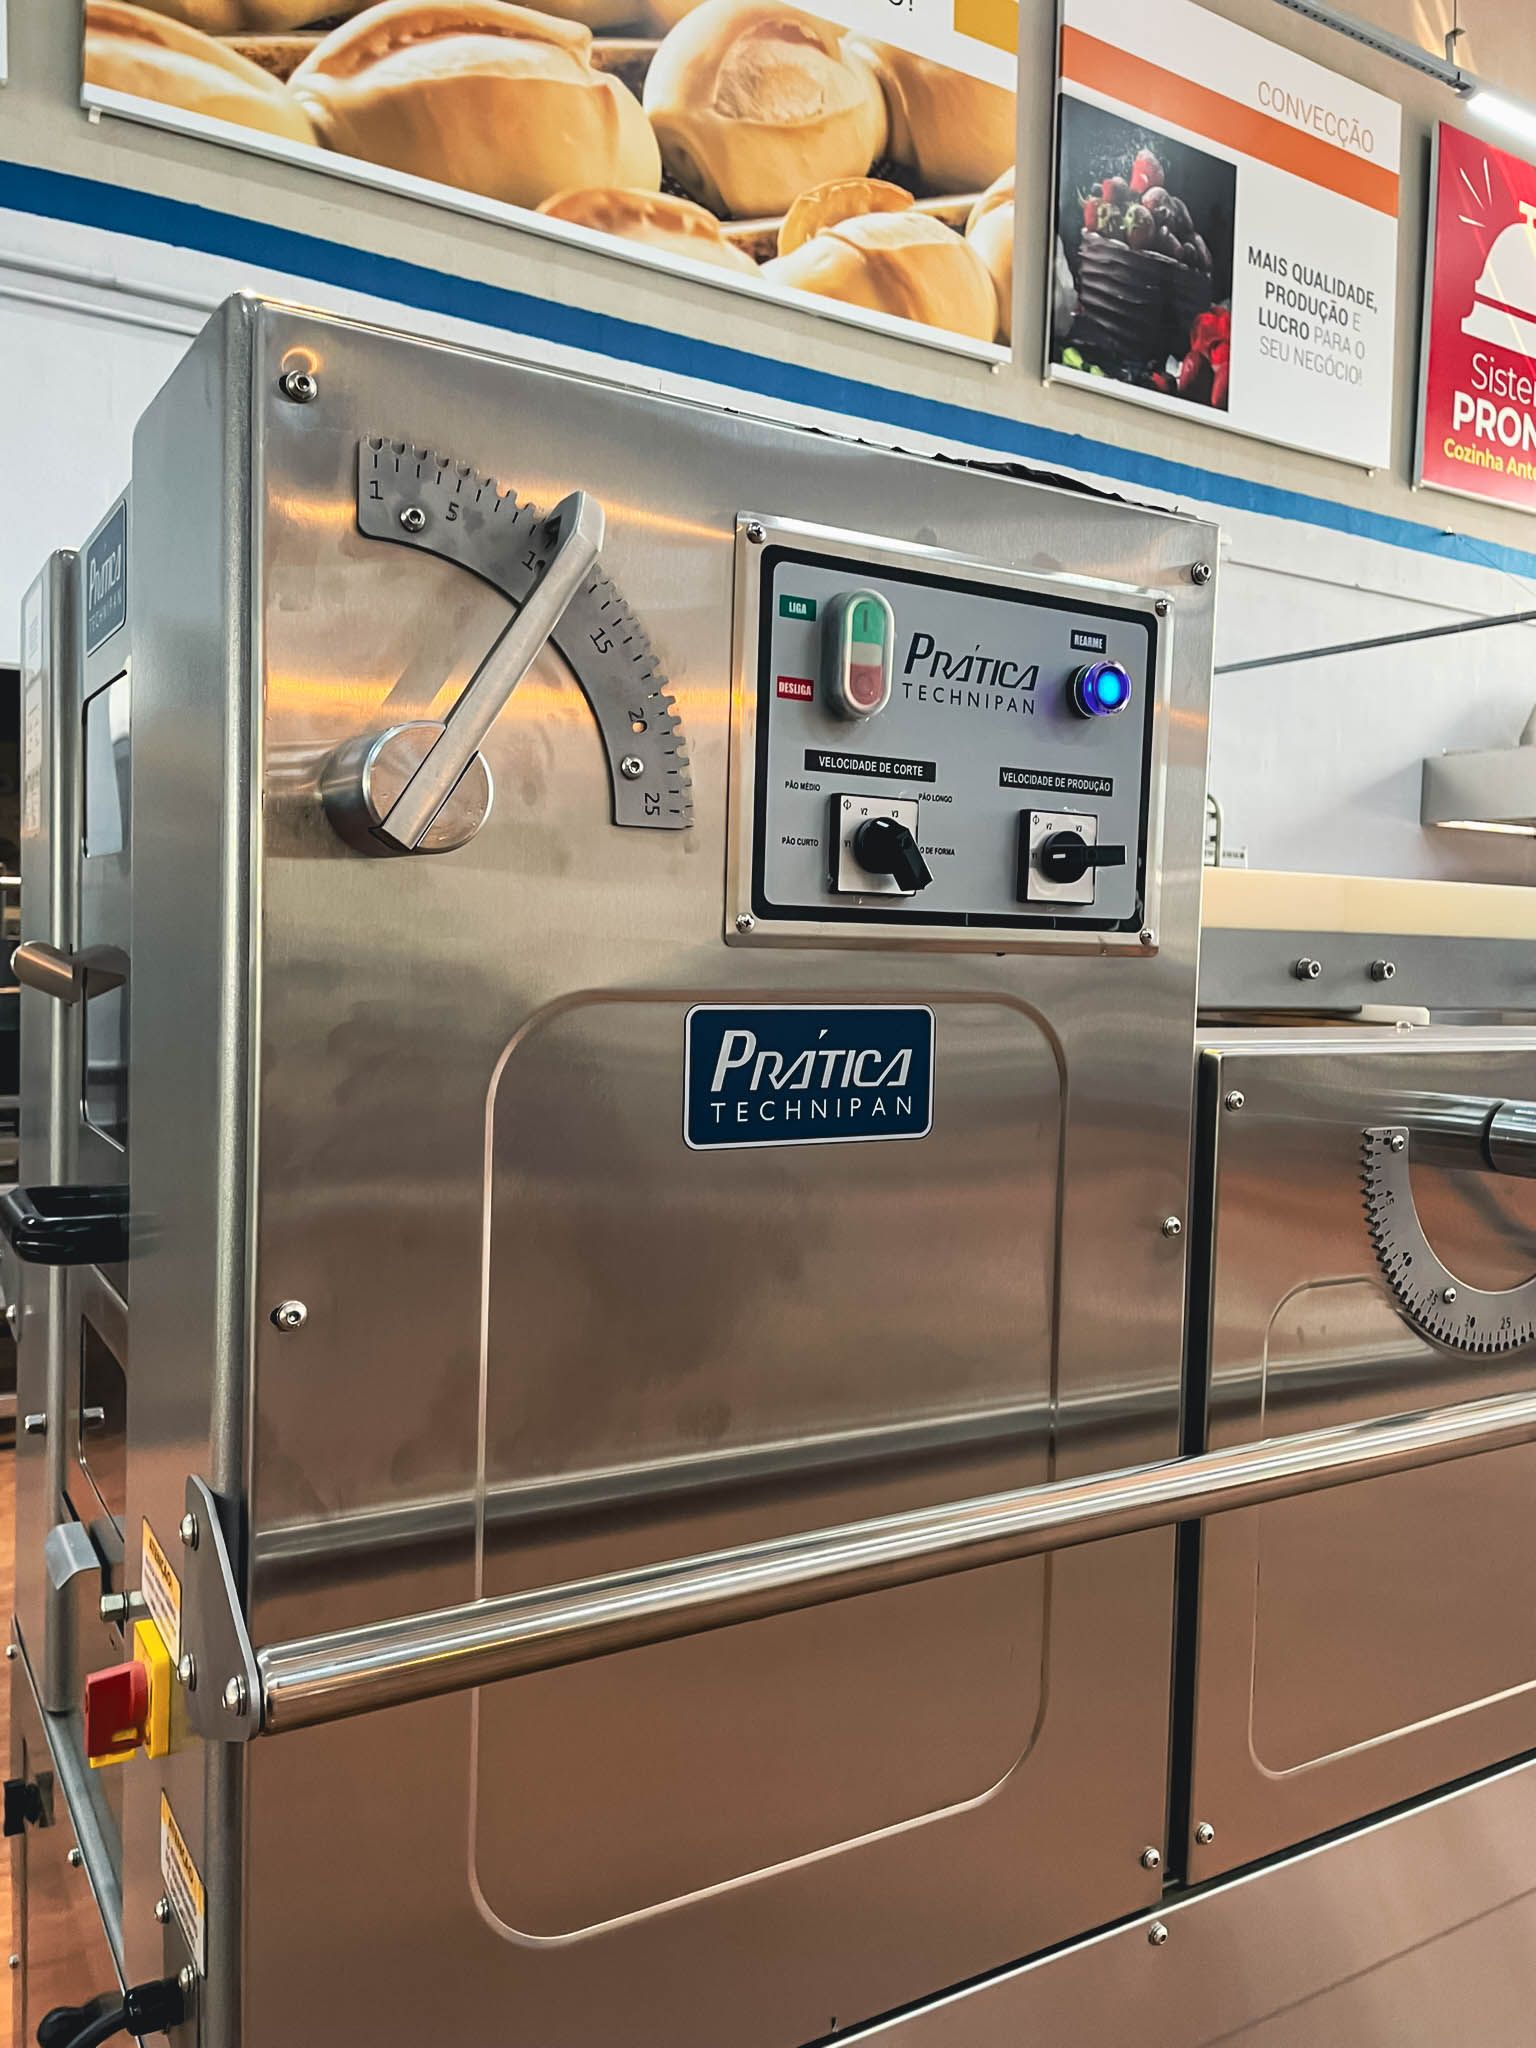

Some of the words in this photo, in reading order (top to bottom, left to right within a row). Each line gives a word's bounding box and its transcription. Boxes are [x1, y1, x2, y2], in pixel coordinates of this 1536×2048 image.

[1258, 81, 1374, 153] CONVECÇÃO
[1248, 246, 1288, 277] MAIS
[1292, 263, 1377, 314] QUALIDADE,
[1265, 281, 1349, 326] PRODUÇÃO
[1352, 312, 1361, 332] E
[1258, 306, 1310, 340] LUCRO
[1313, 326, 1351, 355] PARA
[1355, 340, 1365, 360] O
[1259, 335, 1290, 362] SEU
[1471, 352, 1536, 408] Siste
[1443, 437, 1504, 473] Cozinha
[369, 480, 384, 500] 1
[445, 502, 459, 522] 5
[788, 601, 807, 615] LIGA
[590, 626, 613, 654] 15
[1073, 633, 1103, 650] REARME
[904, 632, 1040, 691] PRÁTICA
[778, 681, 812, 697] DESLIGA
[902, 682, 1035, 715] TECHNIPAN
[628, 706, 648, 734] 20
[818, 755, 877, 772] VELOCIDADE
[879, 762, 892, 774] DE
[893, 764, 924, 777] CORTE
[784, 780, 799, 790] PÃO
[800, 781, 821, 791] MÉDIO
[1002, 771, 1053, 787] VELOCIDADE
[1055, 777, 1066, 788] DE
[1067, 779, 1111, 793] PRODUÇÃO
[644, 792, 660, 816] 25
[918, 793, 931, 801] PÃO
[932, 794, 953, 803] LONGO
[860, 807, 868, 816] V2
[891, 810, 899, 818] V3
[781, 836, 796, 845] PÃO
[796, 837, 819, 847] CURTO
[925, 846, 934, 855] DE
[934, 847, 955, 856] FORMA
[710, 1029, 913, 1092] PRÁTICA
[710, 1095, 912, 1123] TECHNIPAN
[1500, 1317, 1511, 1330] 25
